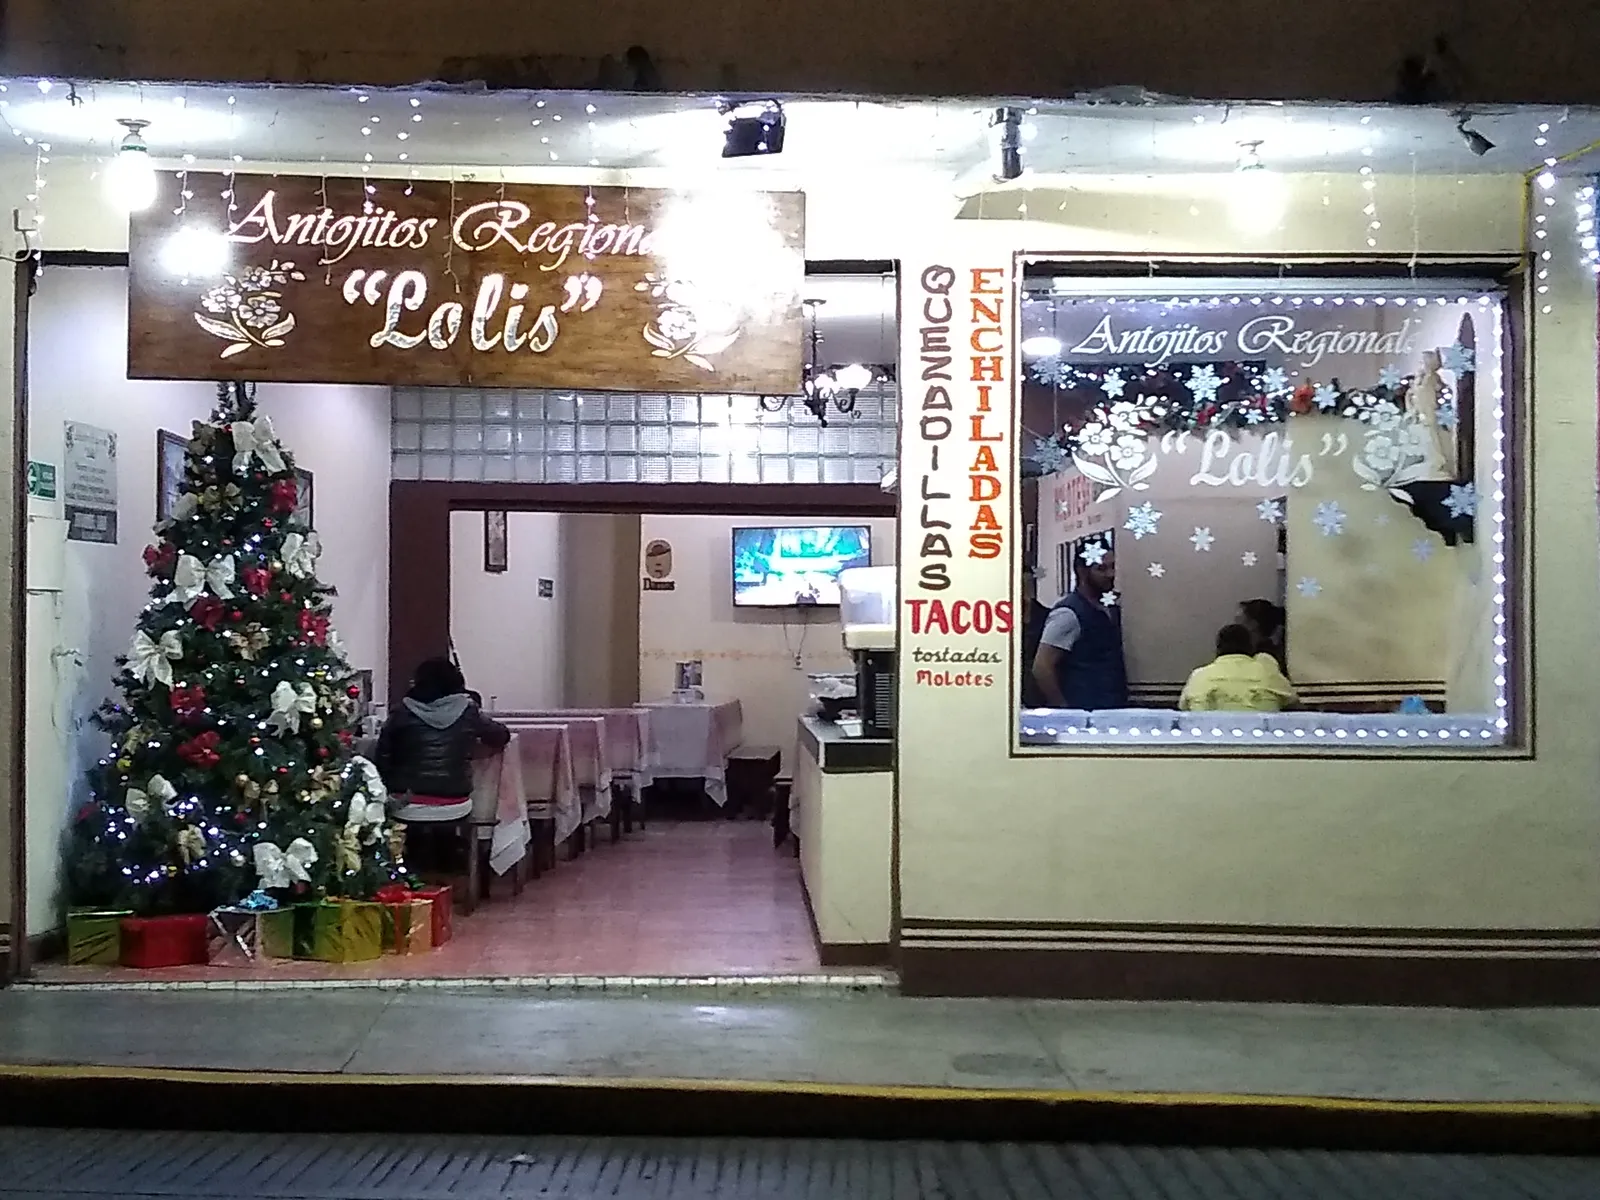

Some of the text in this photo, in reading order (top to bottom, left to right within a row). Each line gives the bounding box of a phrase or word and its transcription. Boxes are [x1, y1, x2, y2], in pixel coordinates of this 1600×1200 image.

[225, 190, 438, 265] Antojitos
[343, 269, 603, 352] “Lolis”
[1070, 314, 1227, 367] Antojitos
[918, 264, 956, 591] QUEZADILLAS
[968, 267, 1004, 559] ENCHILADAS
[904, 599, 1014, 635] TACOS
[912, 646, 1002, 663] tostadas
